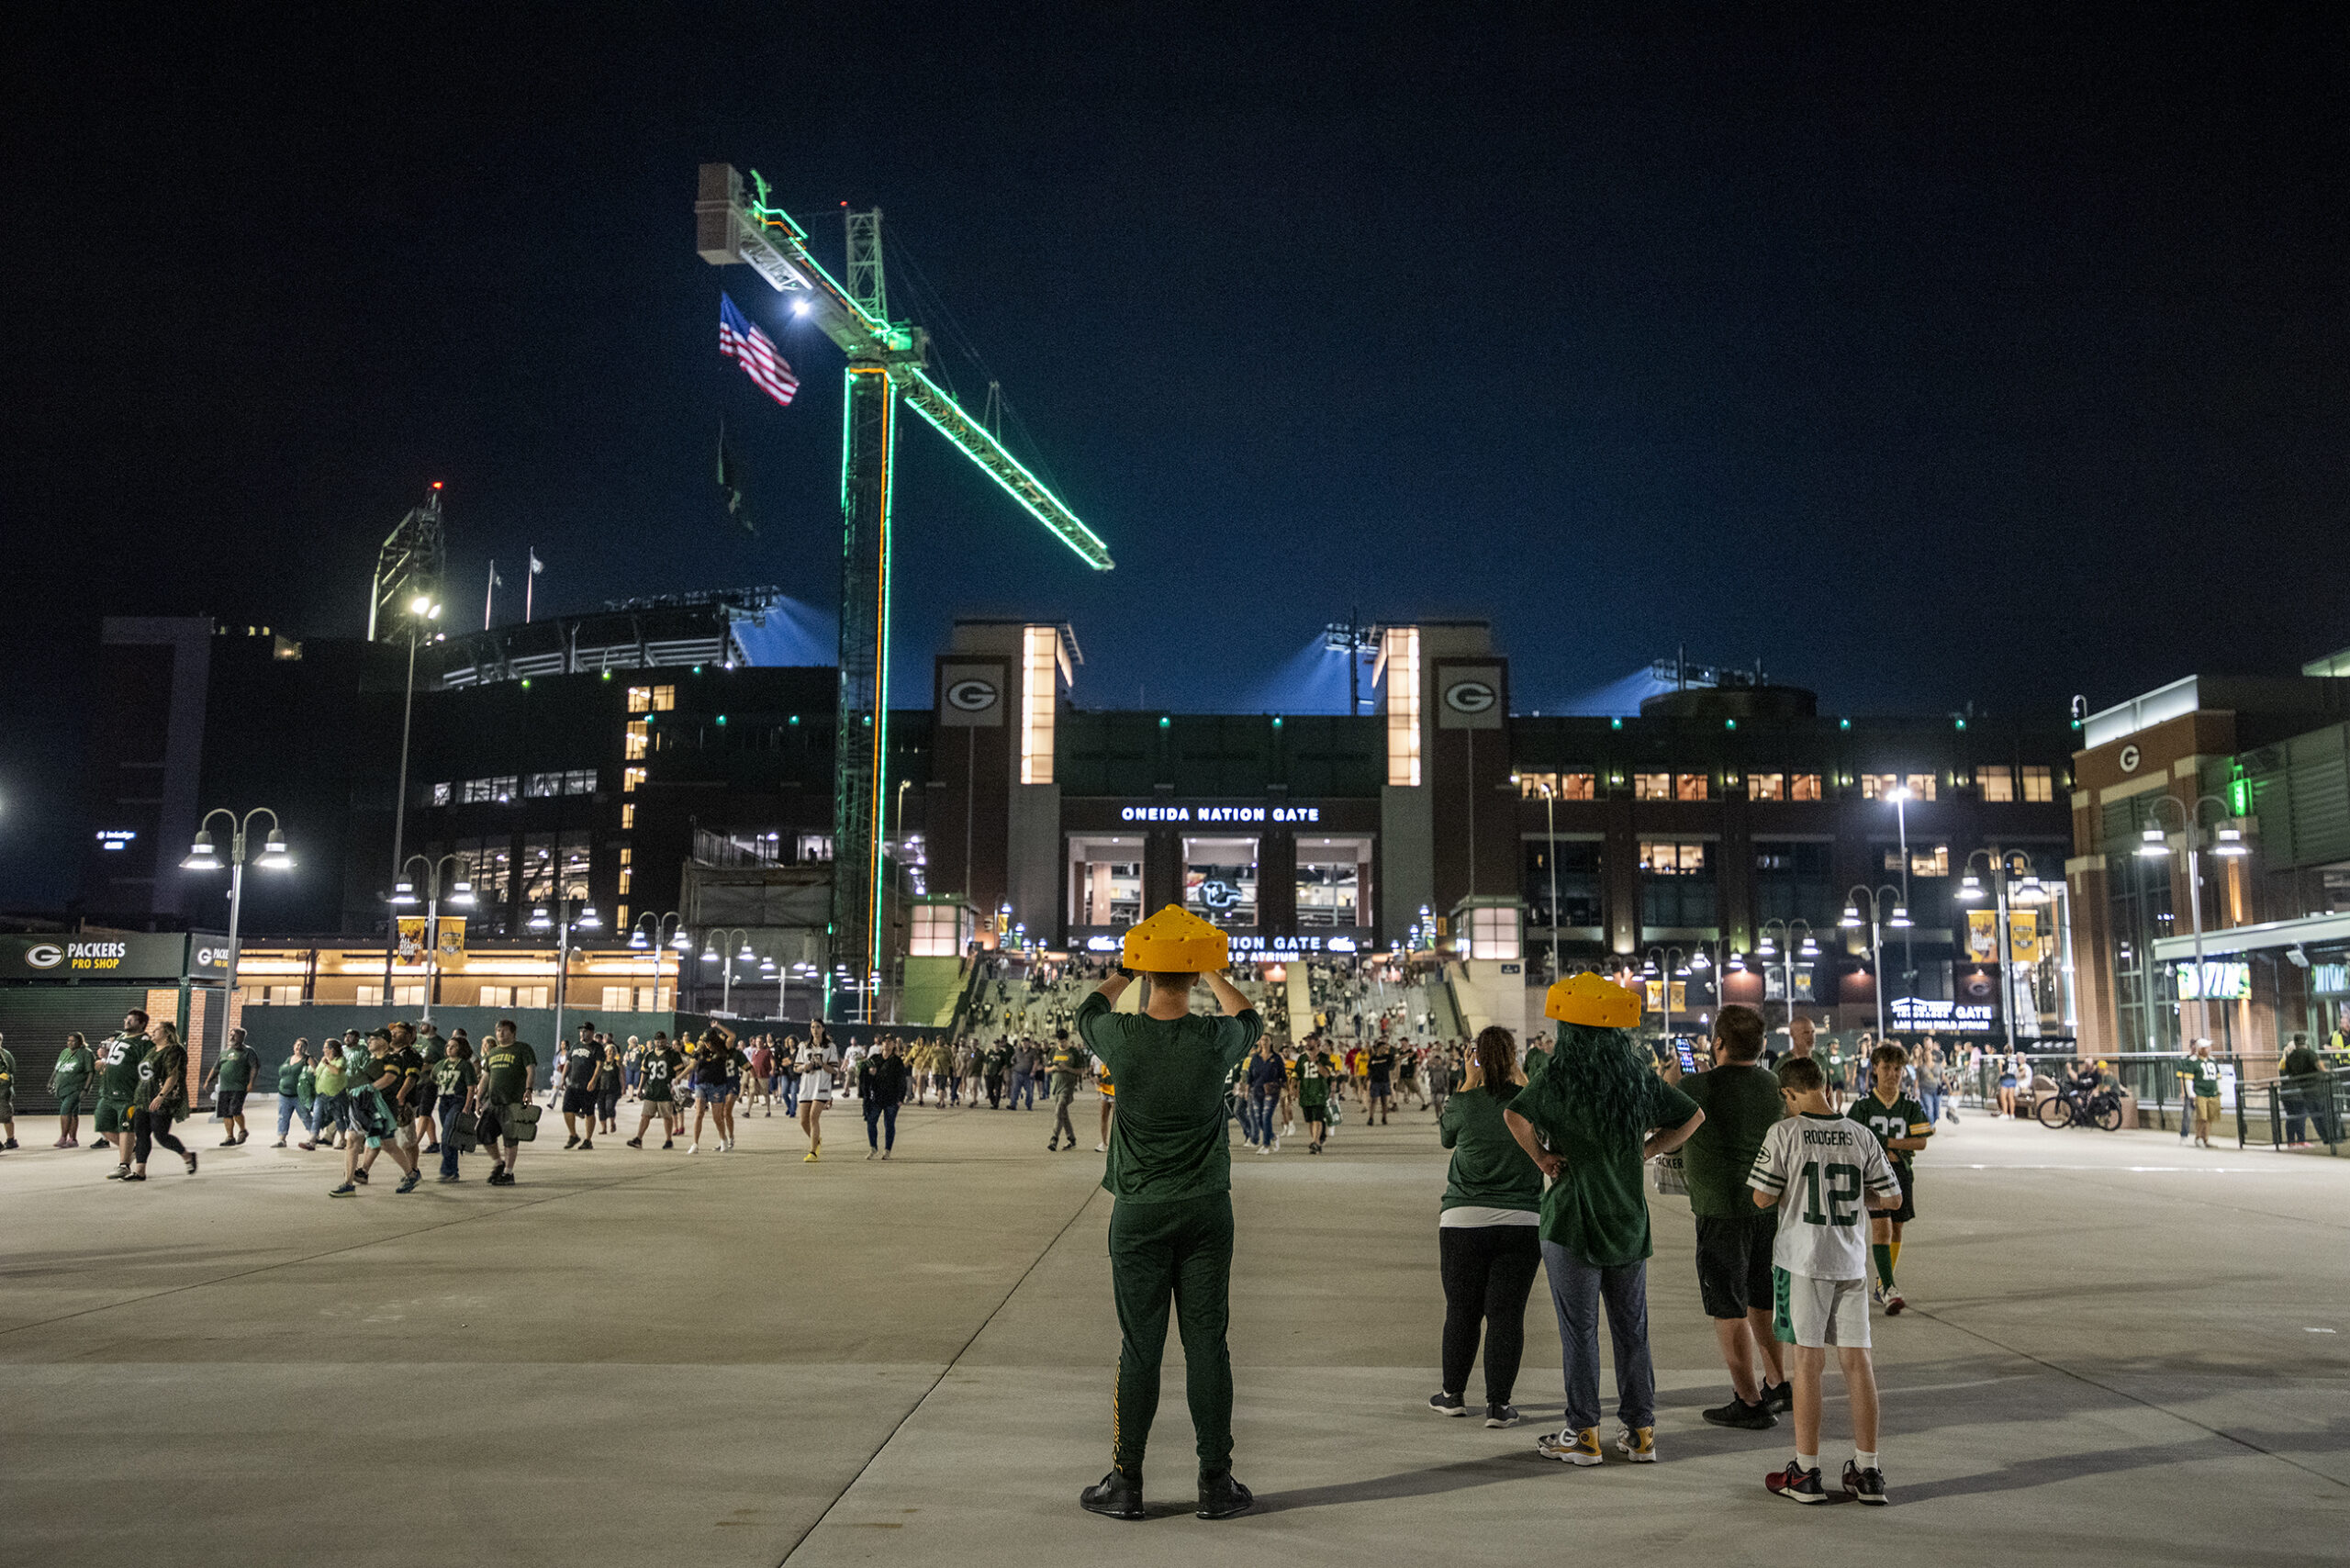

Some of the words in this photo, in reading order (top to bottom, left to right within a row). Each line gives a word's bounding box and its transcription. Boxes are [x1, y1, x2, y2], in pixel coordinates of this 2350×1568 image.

[949, 681, 996, 711] G
[1448, 683, 1494, 711] G
[2120, 745, 2140, 773] G
[1121, 807, 1190, 822] ONEIDA
[1197, 807, 1266, 822] NATION
[1272, 808, 1320, 823] GATE
[67, 942, 126, 958] PACKERS
[1228, 936, 1266, 950] ION
[1273, 936, 1322, 950] GATE
[26, 943, 64, 969] G
[197, 947, 212, 966] G
[213, 948, 229, 959] PACKE
[1249, 952, 1300, 962] ATRIUM
[72, 958, 91, 969] PRO
[94, 958, 119, 969] SHOP
[1955, 1005, 1992, 1019] GATE
[138, 1061, 154, 1081] G
[648, 1060, 667, 1081] 33
[1304, 1061, 1319, 1079] 12
[2200, 1062, 2217, 1081] 19
[1803, 1130, 1853, 1147] RODGERS
[1802, 1161, 1862, 1226] 12
